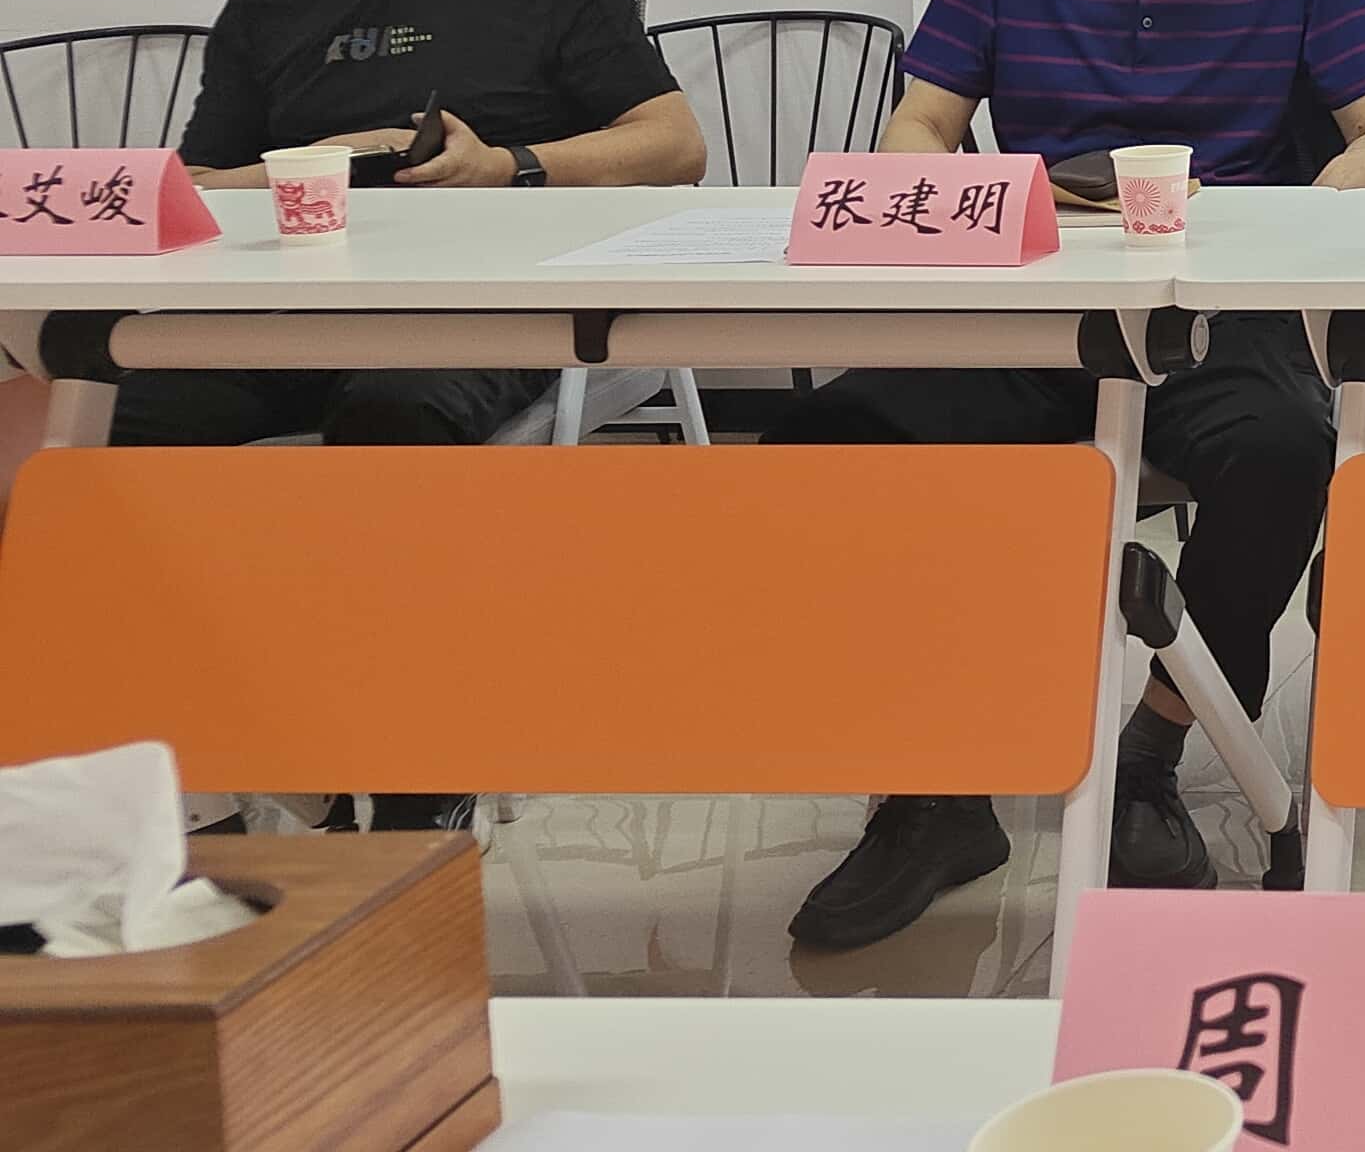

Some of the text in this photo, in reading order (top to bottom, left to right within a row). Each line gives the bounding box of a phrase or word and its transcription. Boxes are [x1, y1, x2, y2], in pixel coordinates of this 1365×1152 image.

[0, 164, 146, 226] 艾峻
[810, 175, 1013, 237] 张建明
